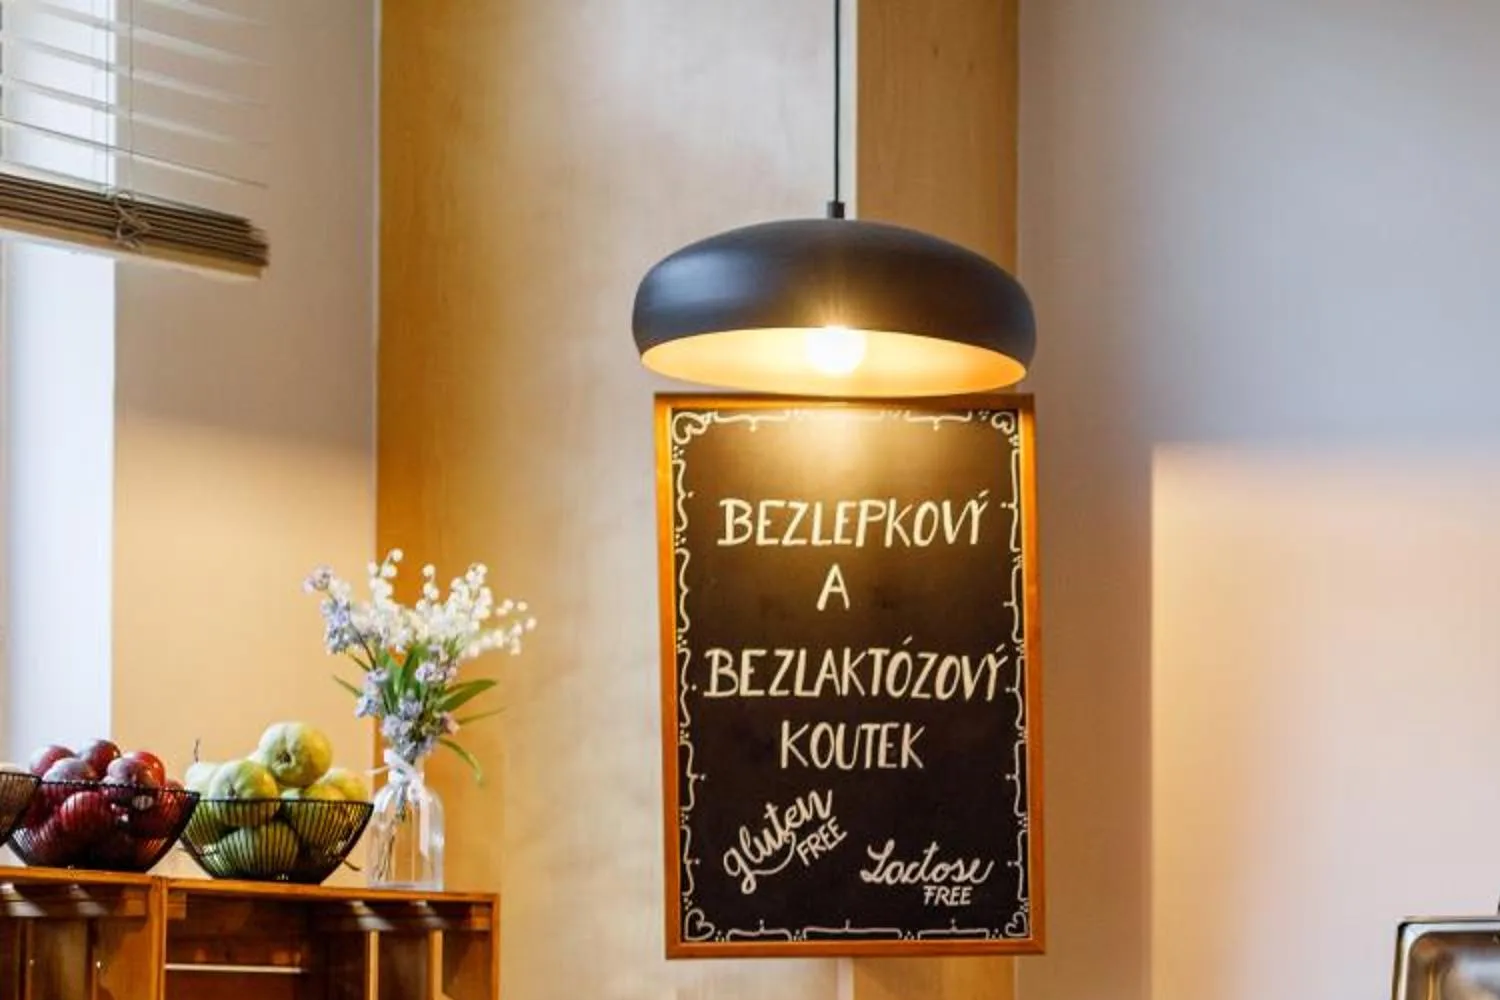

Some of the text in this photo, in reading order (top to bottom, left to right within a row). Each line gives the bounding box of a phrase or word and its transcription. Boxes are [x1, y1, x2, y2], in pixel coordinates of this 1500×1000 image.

[717, 490, 990, 547] BEZLEPKOVÝ
[816, 564, 851, 611] A
[703, 636, 1009, 701] BEZLAKTÓZOVÝ
[781, 721, 926, 769] KOUTEK
[722, 789, 834, 895] gluten
[796, 815, 848, 867] FREE
[859, 839, 995, 885] Lactose
[923, 885, 974, 906] FREE
